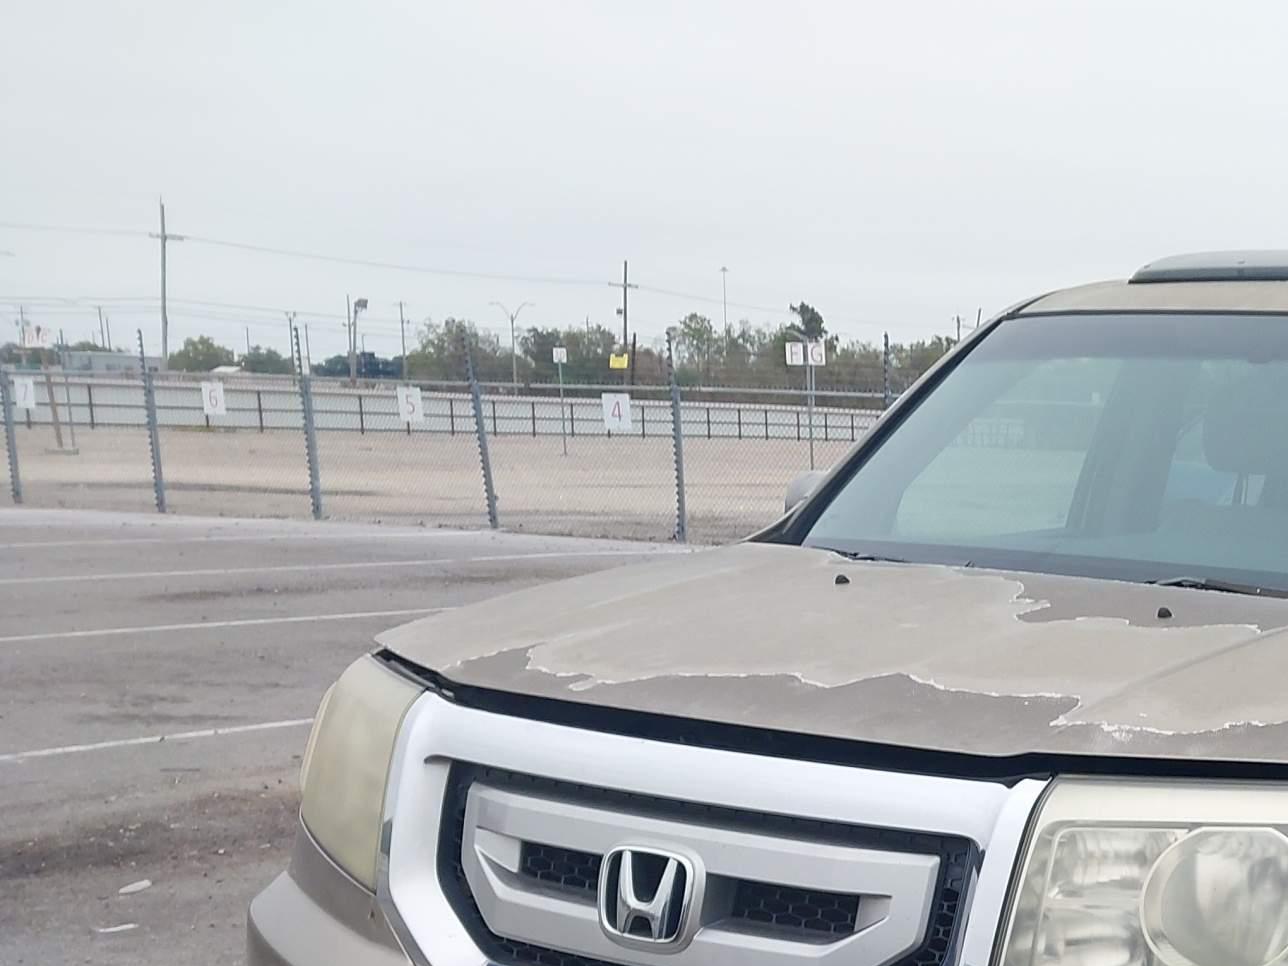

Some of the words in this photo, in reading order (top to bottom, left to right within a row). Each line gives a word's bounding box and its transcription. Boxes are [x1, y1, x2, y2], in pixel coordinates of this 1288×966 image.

[208, 388, 218, 408] 6
[405, 393, 416, 415] 5
[611, 400, 623, 422] 4
